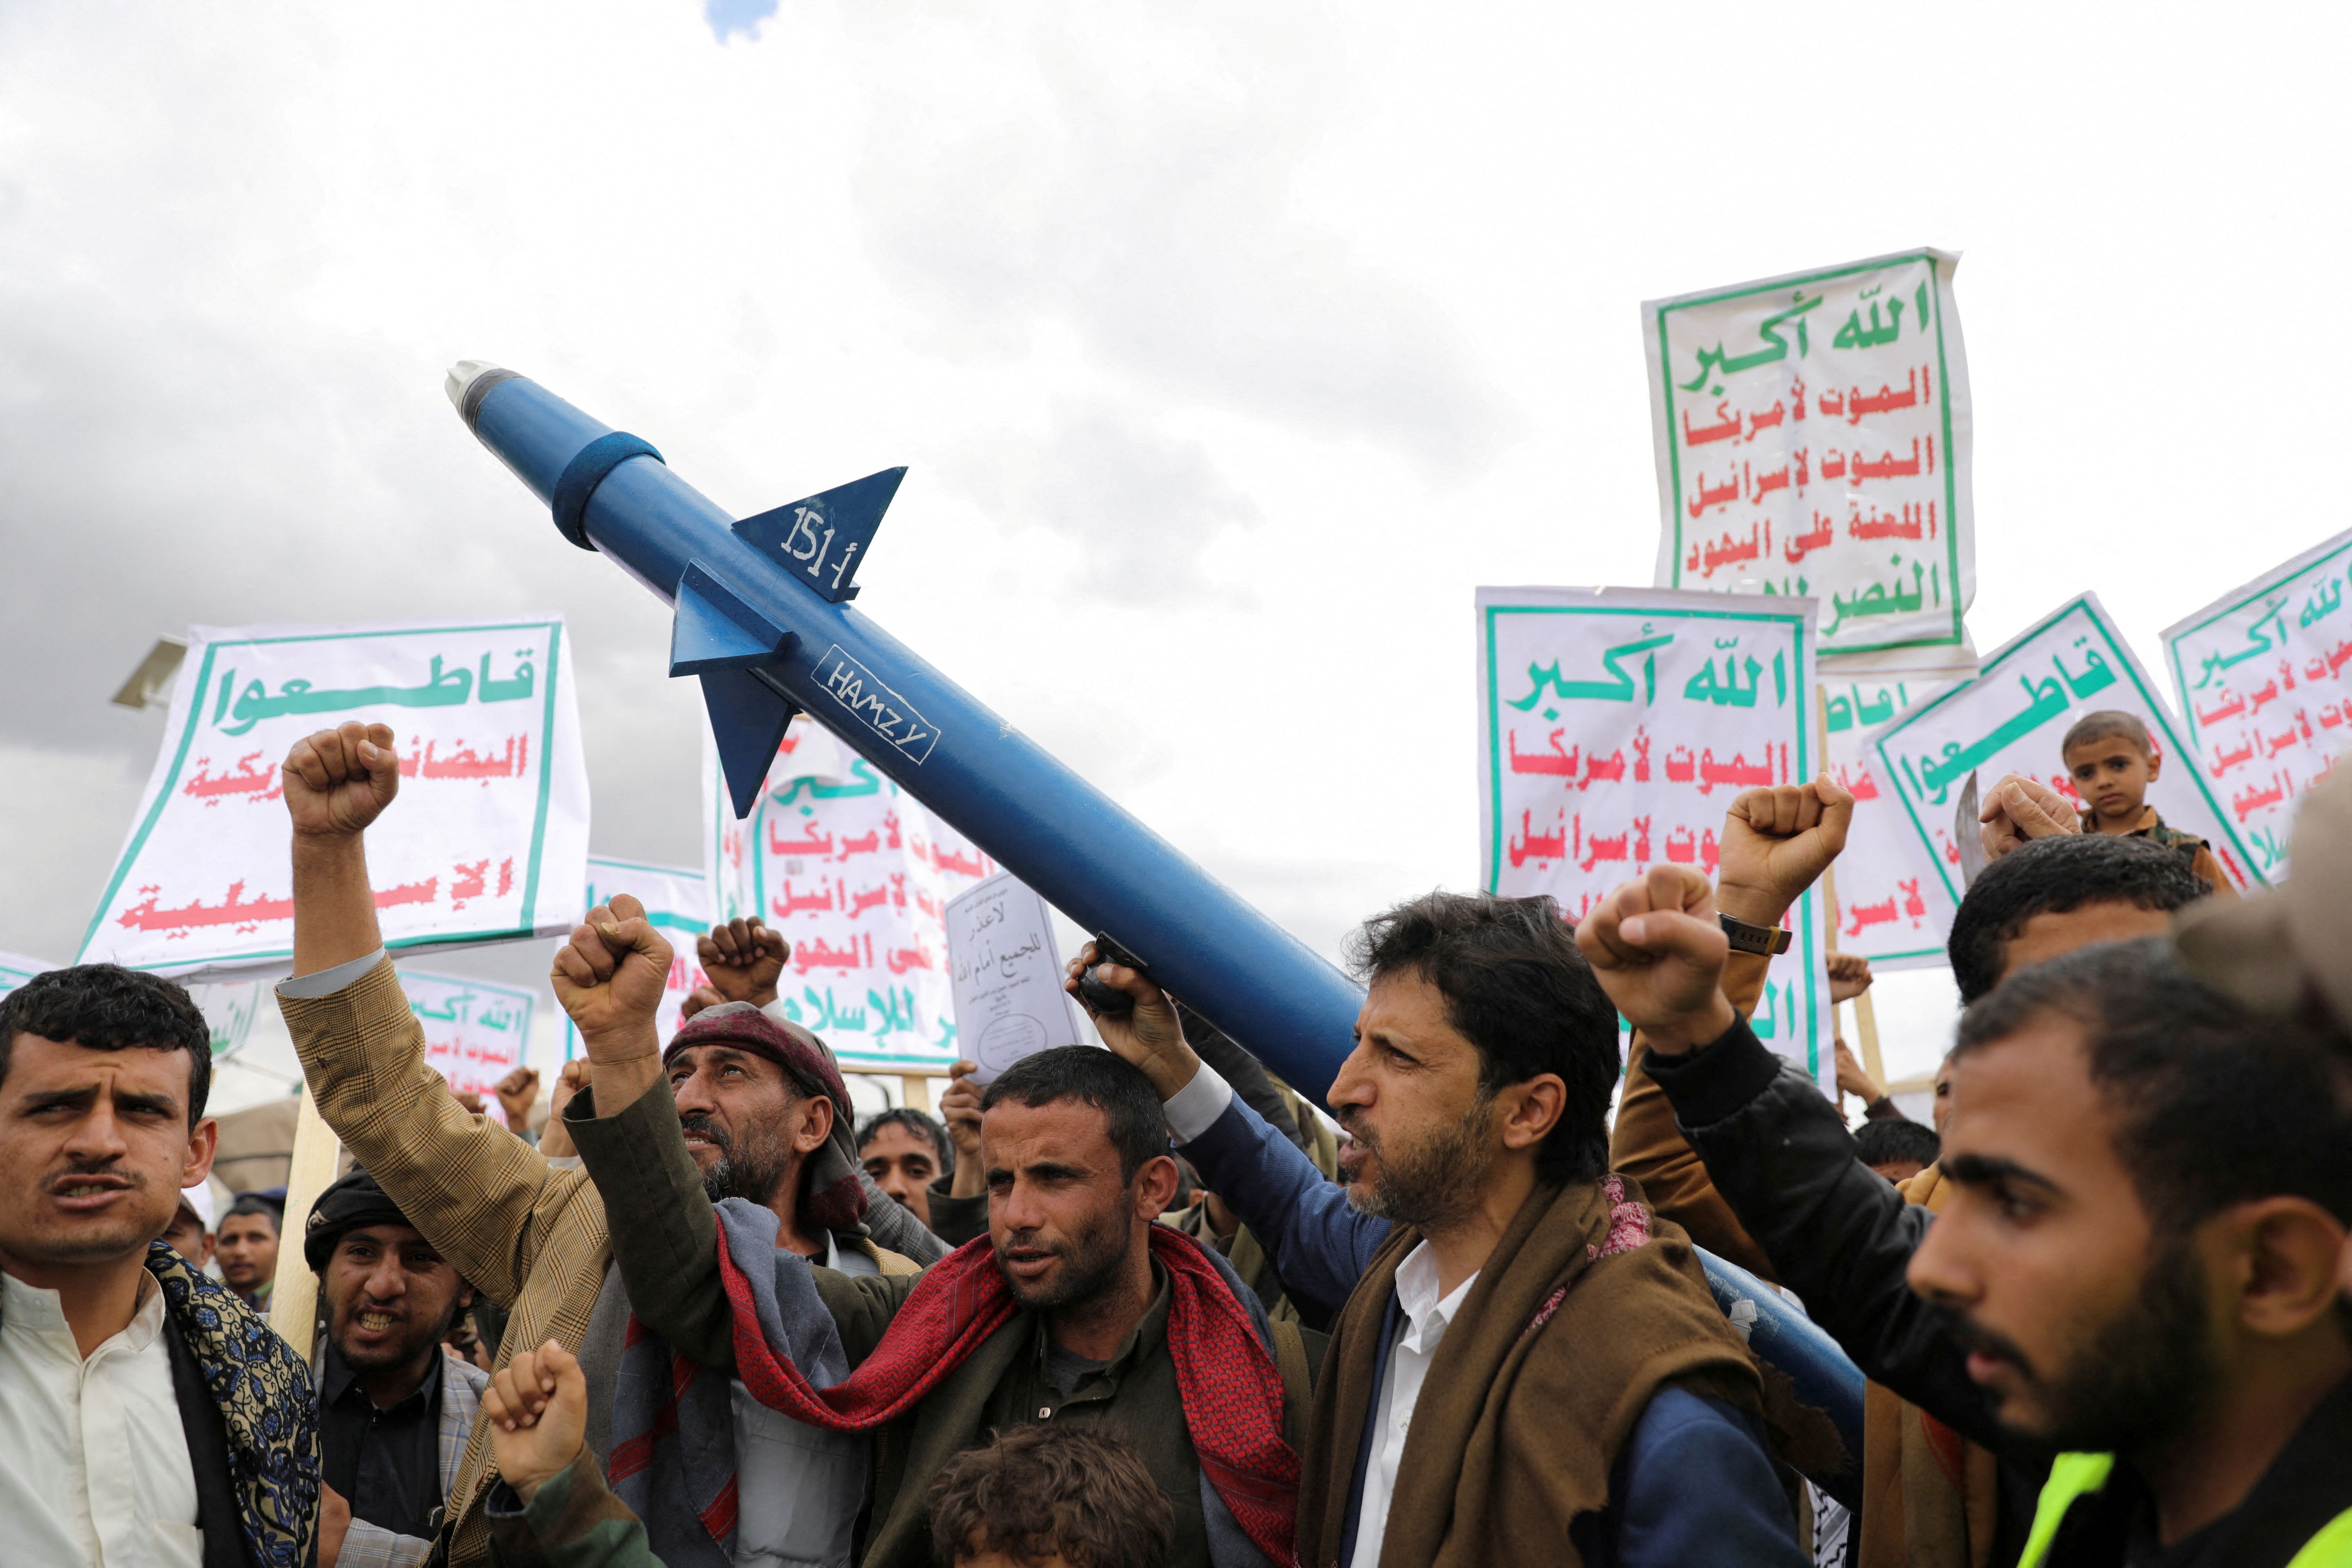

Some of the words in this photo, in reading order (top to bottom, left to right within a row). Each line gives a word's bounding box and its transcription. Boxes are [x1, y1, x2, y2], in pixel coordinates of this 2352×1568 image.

[1678, 292, 1822, 396] أكبر
[1682, 374, 1807, 448] لأمريكا
[1818, 363, 1931, 426] الموت
[1687, 446, 1809, 520] لإسرائيل
[1820, 433, 1935, 487] الموت
[1686, 520, 1772, 579] اليهود
[1784, 510, 1834, 565] على
[1848, 500, 1937, 541] اللعنة
[1819, 553, 1940, 637] النصر
[2299, 560, 2352, 629] لله
[1506, 622, 1675, 722] أكبر
[2192, 595, 2288, 690] أكبر
[213, 649, 535, 737] قاطعوا
[828, 661, 927, 745] HAMZY
[1900, 636, 2117, 805] قاطعوا
[2196, 660, 2294, 727] لأمريكا
[391, 732, 528, 787] البضائ
[1509, 725, 1651, 791] لأمريكا
[1664, 740, 1788, 796] الموت
[2234, 767, 2294, 823] اليهو
[769, 808, 902, 862] لأمريكا
[772, 872, 907, 920] لإسرائيل
[783, 931, 874, 977] اليهو
